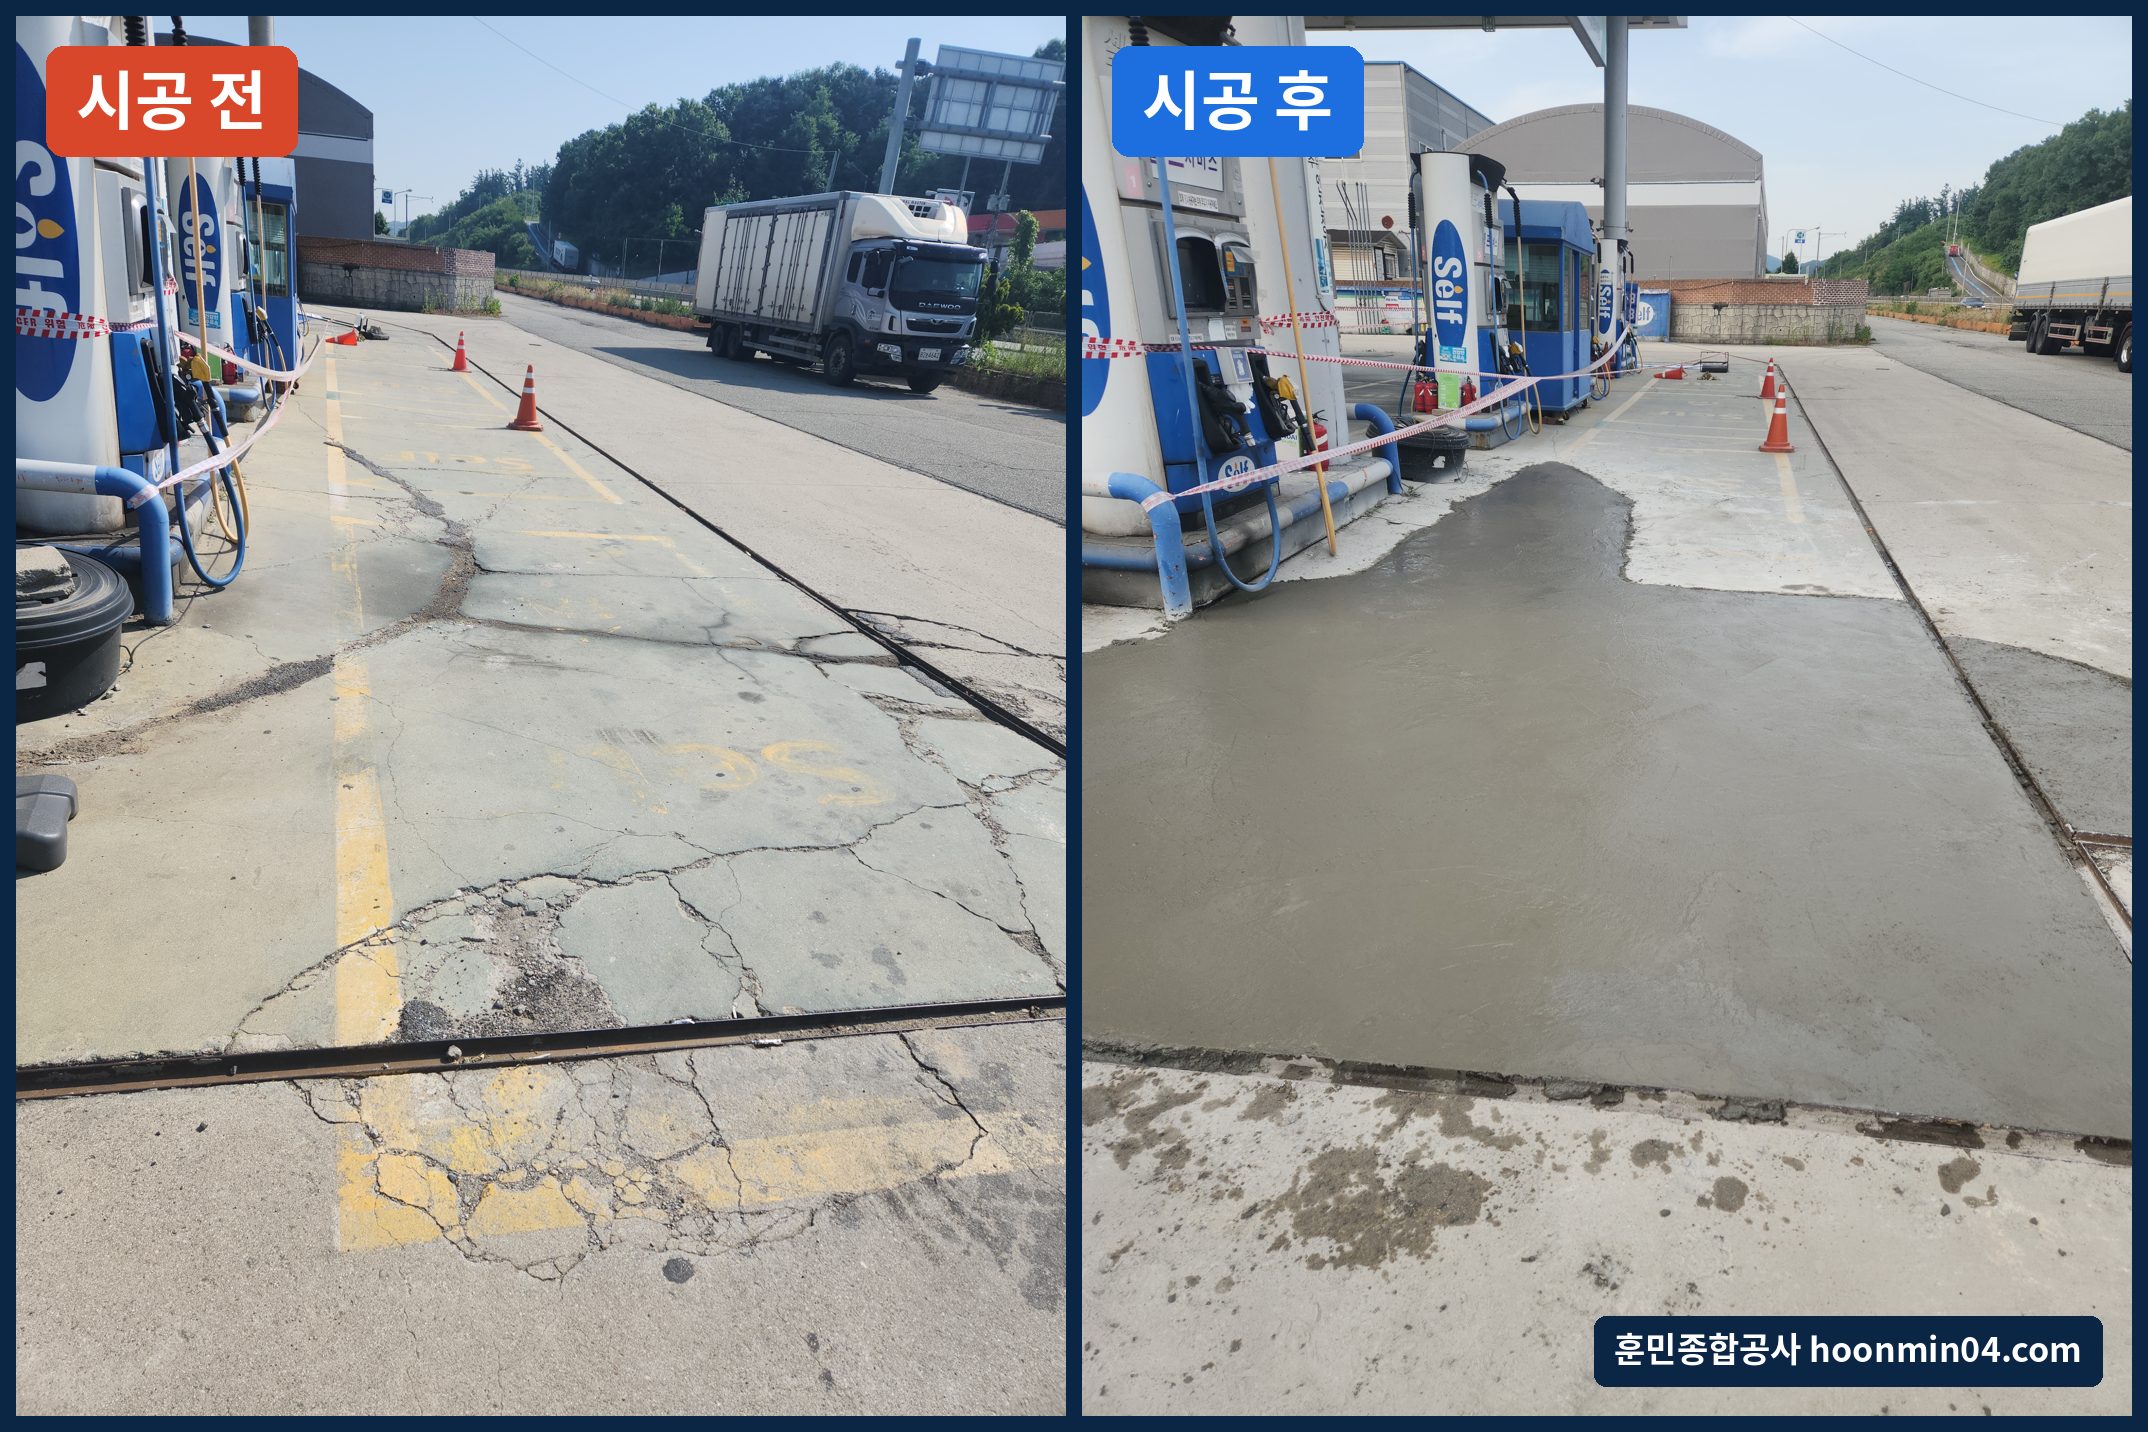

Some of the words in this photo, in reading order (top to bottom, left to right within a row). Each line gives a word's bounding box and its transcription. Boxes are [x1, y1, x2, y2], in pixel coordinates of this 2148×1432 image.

[1434, 256, 1463, 325] Self
[1600, 286, 1611, 319] Self
[919, 302, 961, 310] DAEWOO
[1637, 306, 1651, 321] elf
